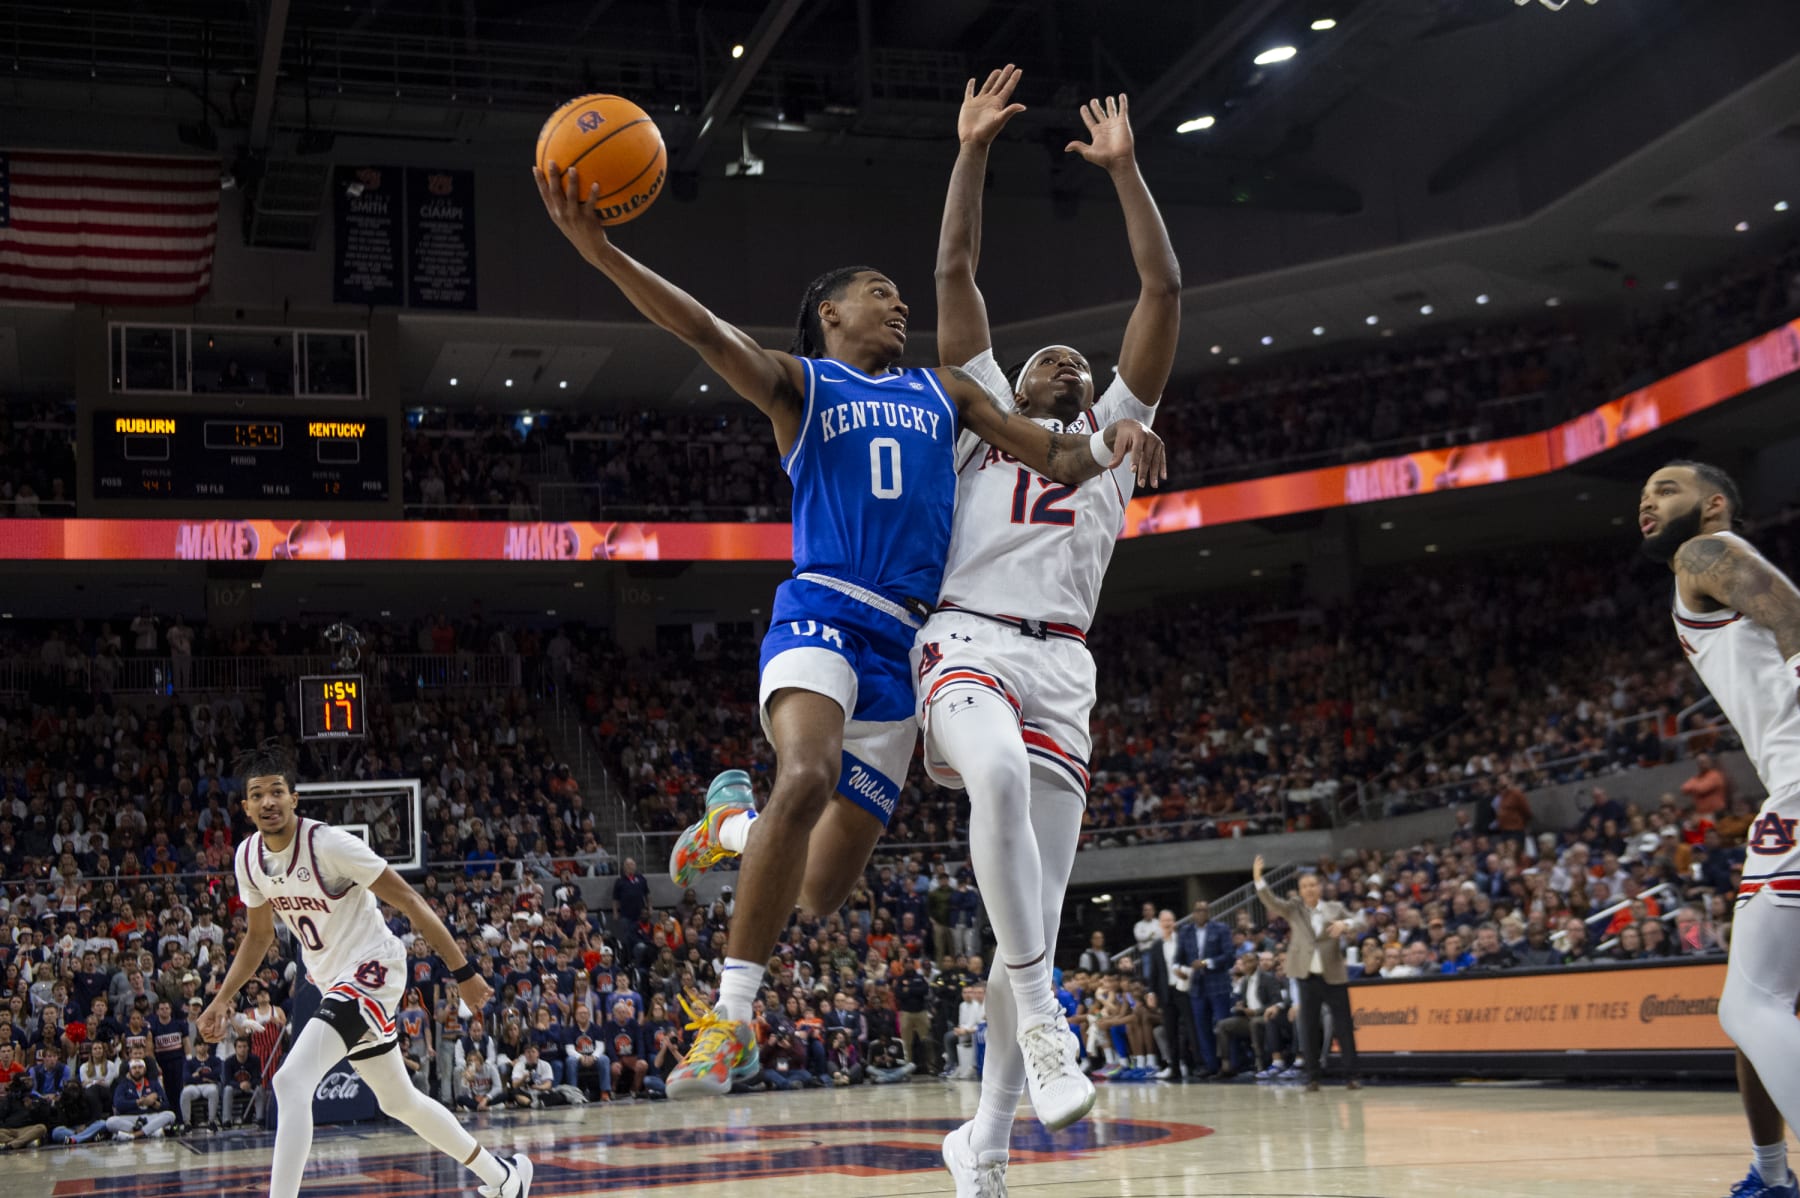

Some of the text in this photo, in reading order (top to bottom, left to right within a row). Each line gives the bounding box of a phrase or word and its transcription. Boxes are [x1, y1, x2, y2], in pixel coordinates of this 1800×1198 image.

[594, 169, 664, 220] Wilson
[115, 418, 176, 434] AUBURN
[235, 424, 278, 447] 1:54
[308, 422, 366, 439] KENTUCKY
[820, 401, 940, 443] KENTUCKY
[230, 456, 256, 466] PERIOD
[869, 437, 902, 500] 0
[1010, 467, 1079, 527] 12
[181, 519, 250, 560] MAKE
[507, 521, 575, 560] MAKE
[324, 681, 356, 700] 1:54
[325, 700, 352, 731] 17
[288, 914, 325, 951] 10
[1427, 1008, 1450, 1025] THE
[1455, 1006, 1501, 1025] SMART
[1504, 1004, 1559, 1023] CHOICE
[1562, 1003, 1580, 1021] IN
[1585, 1001, 1630, 1021] TIRES
[1639, 994, 1722, 1024] Continenta
[316, 1071, 360, 1100] Cola
